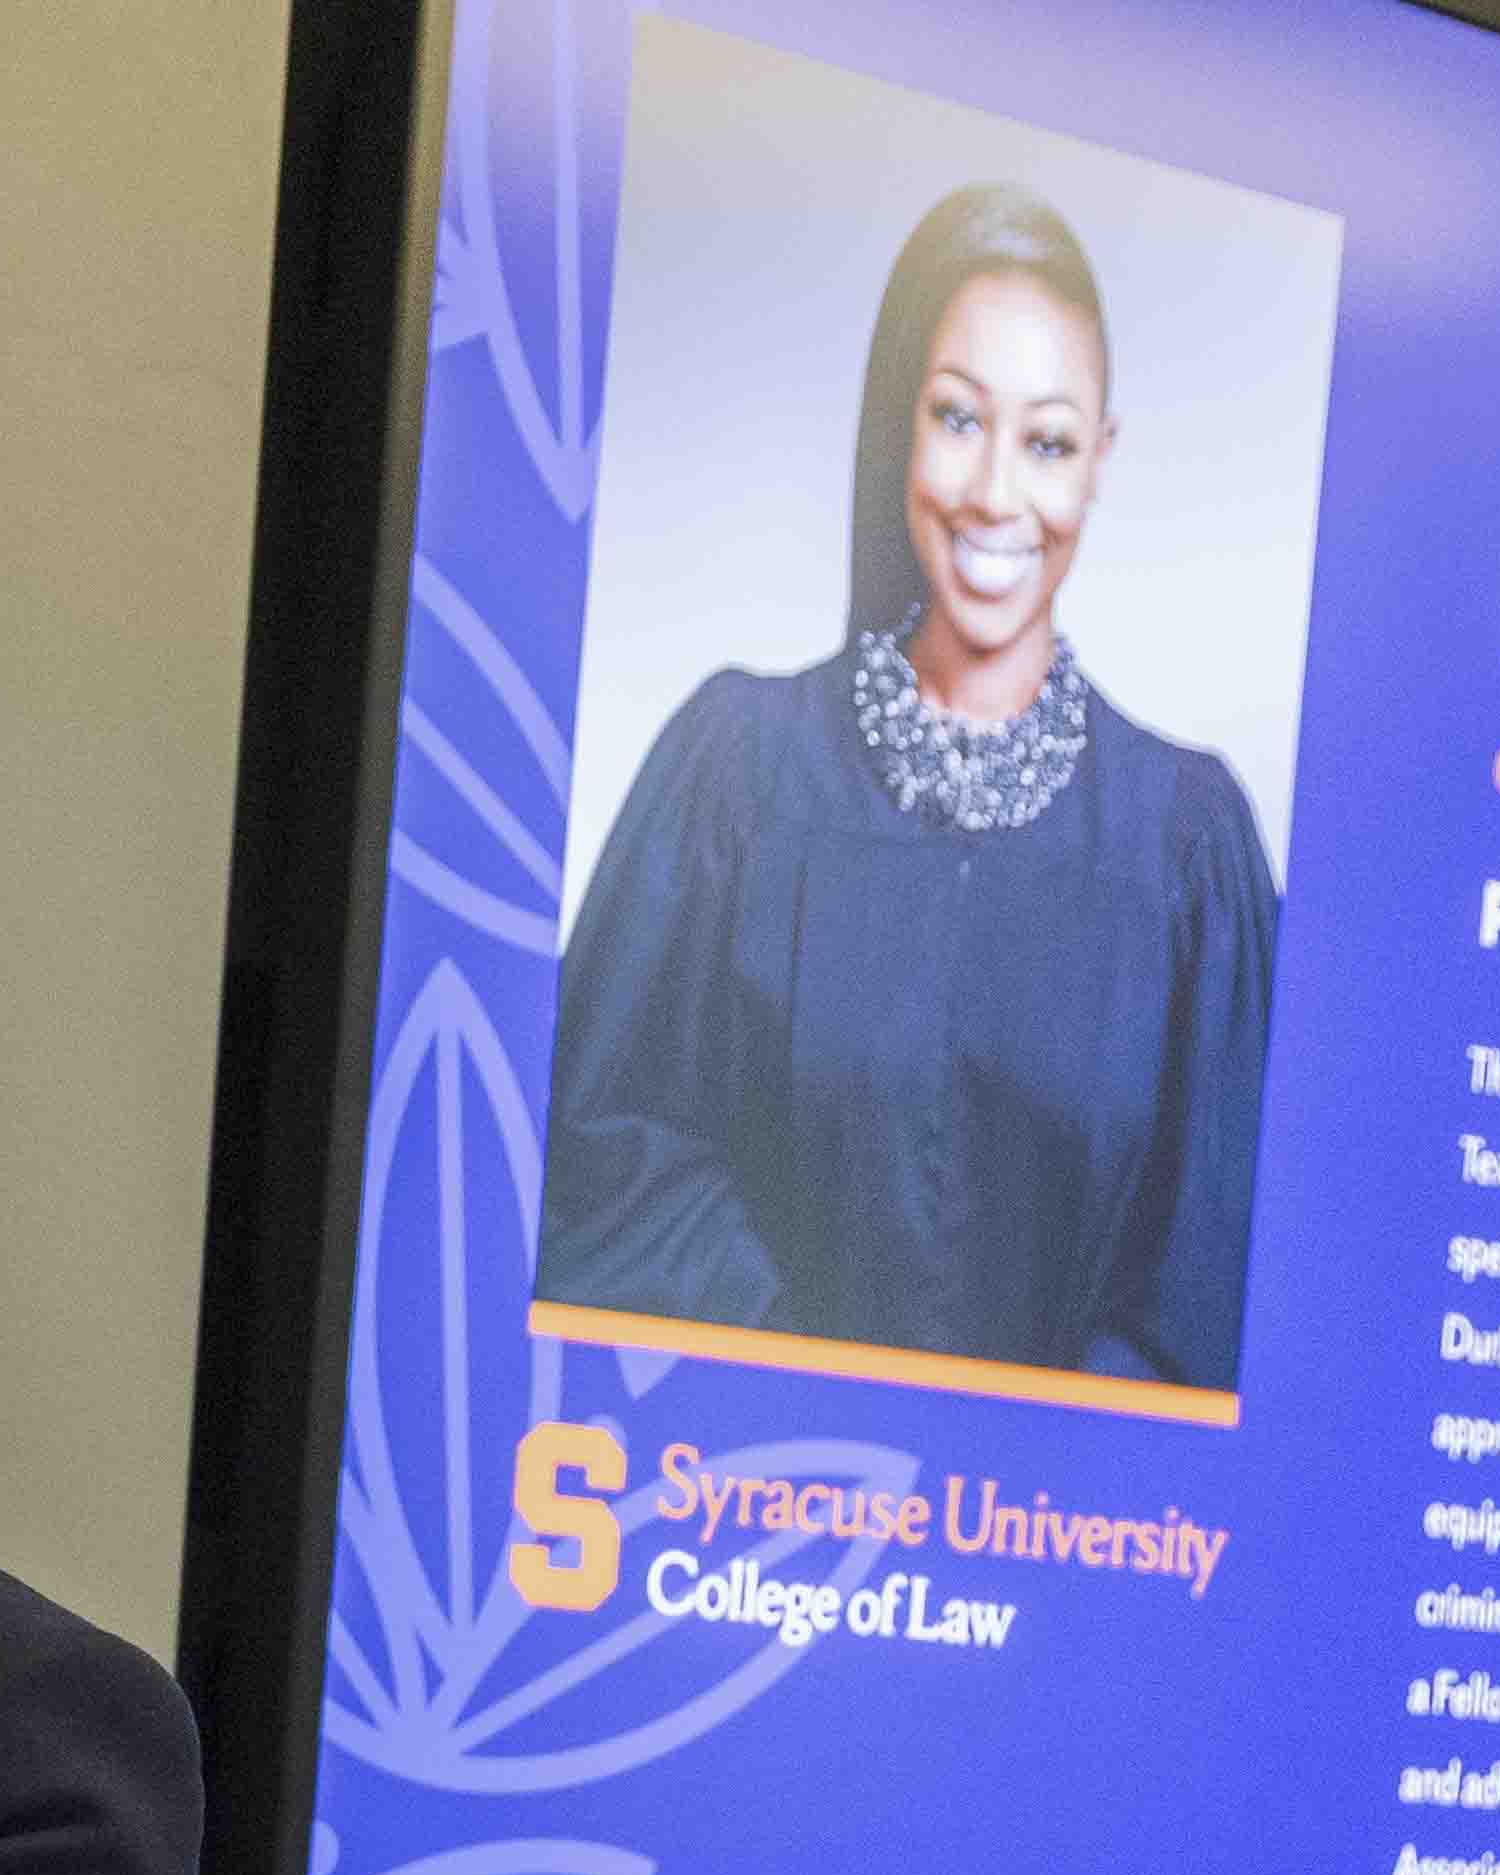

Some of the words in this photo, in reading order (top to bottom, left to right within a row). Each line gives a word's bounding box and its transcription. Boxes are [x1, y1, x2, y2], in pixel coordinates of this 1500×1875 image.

[509, 1420, 627, 1612] S
[657, 1442, 930, 1547] Syracuse
[944, 1475, 1229, 1599] University
[645, 1550, 841, 1646] College
[847, 1573, 911, 1639] of
[905, 1576, 1016, 1648] Law
[1405, 1678, 1432, 1714] a
[1397, 1758, 1463, 1805] and
